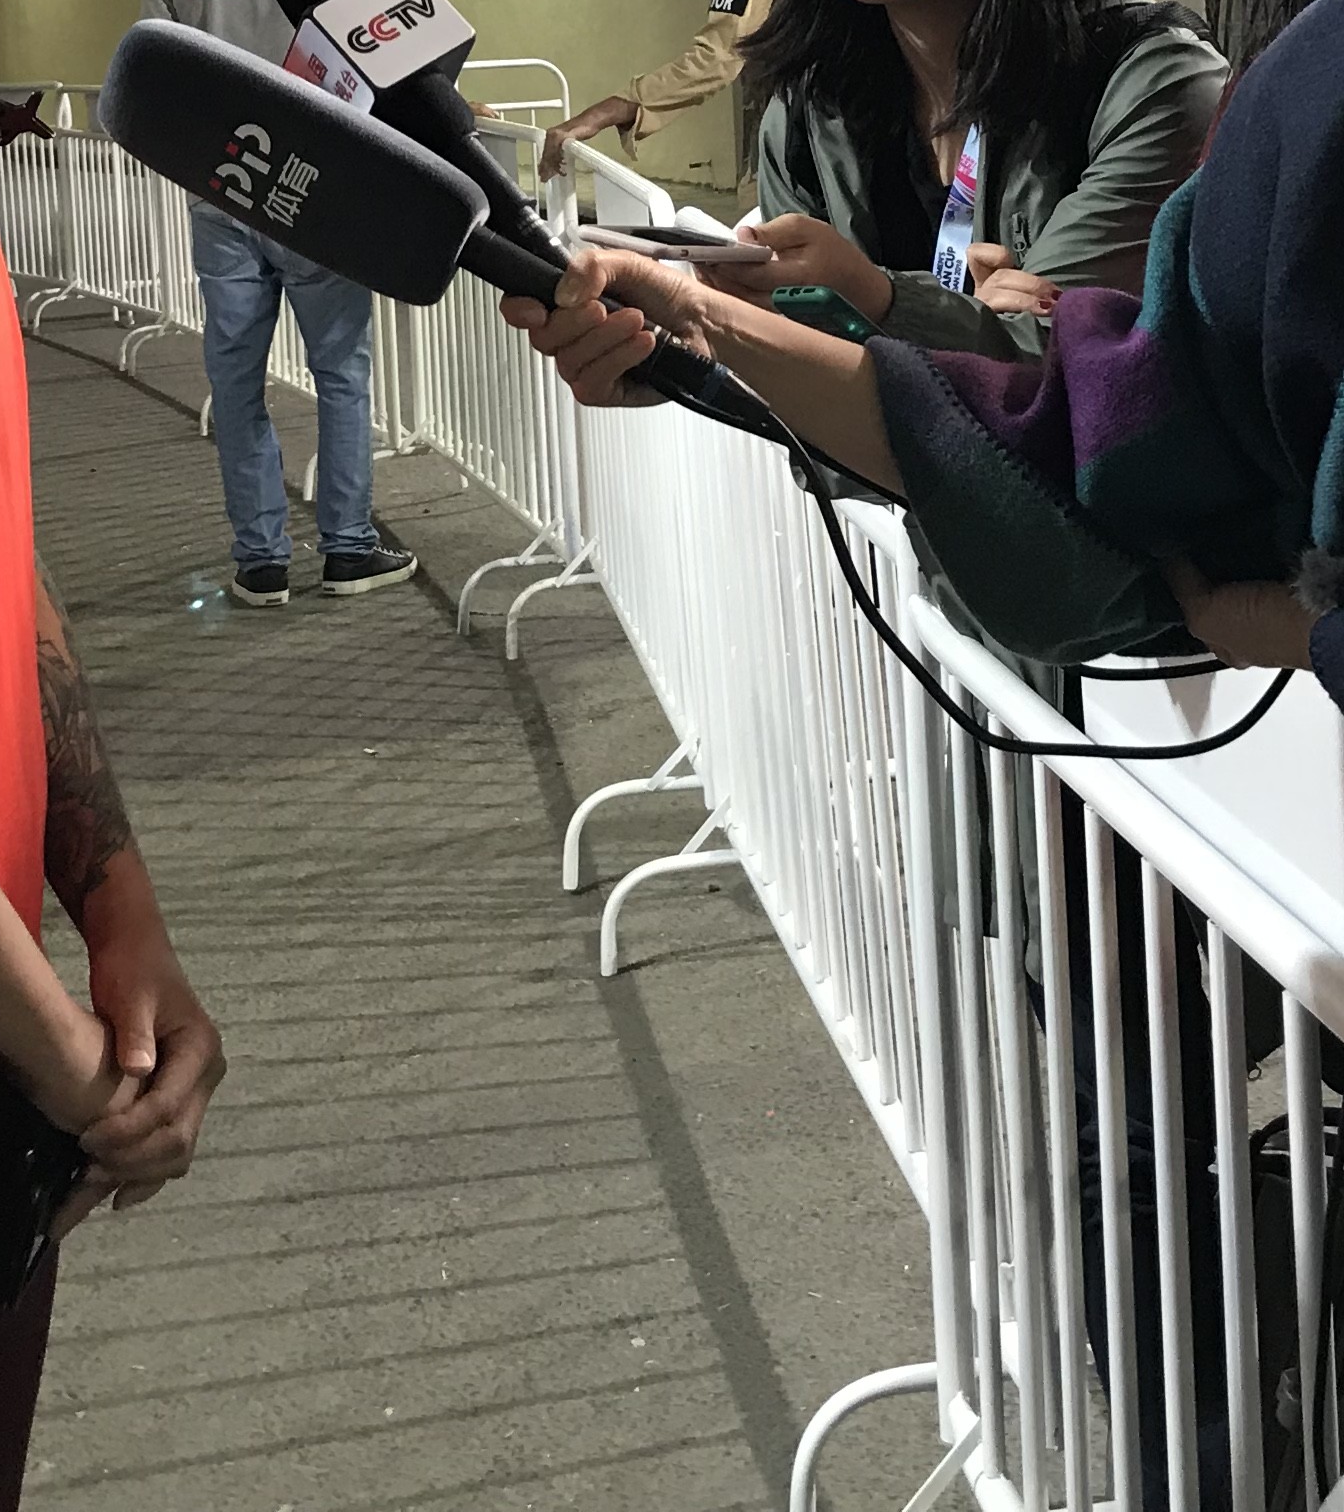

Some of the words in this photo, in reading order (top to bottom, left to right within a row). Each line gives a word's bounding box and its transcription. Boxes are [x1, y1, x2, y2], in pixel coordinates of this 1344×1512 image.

[262, 152, 320, 228] 体育
[936, 251, 946, 280] OMEN'S
[945, 246, 956, 269] CUP
[942, 270, 953, 289] AN
